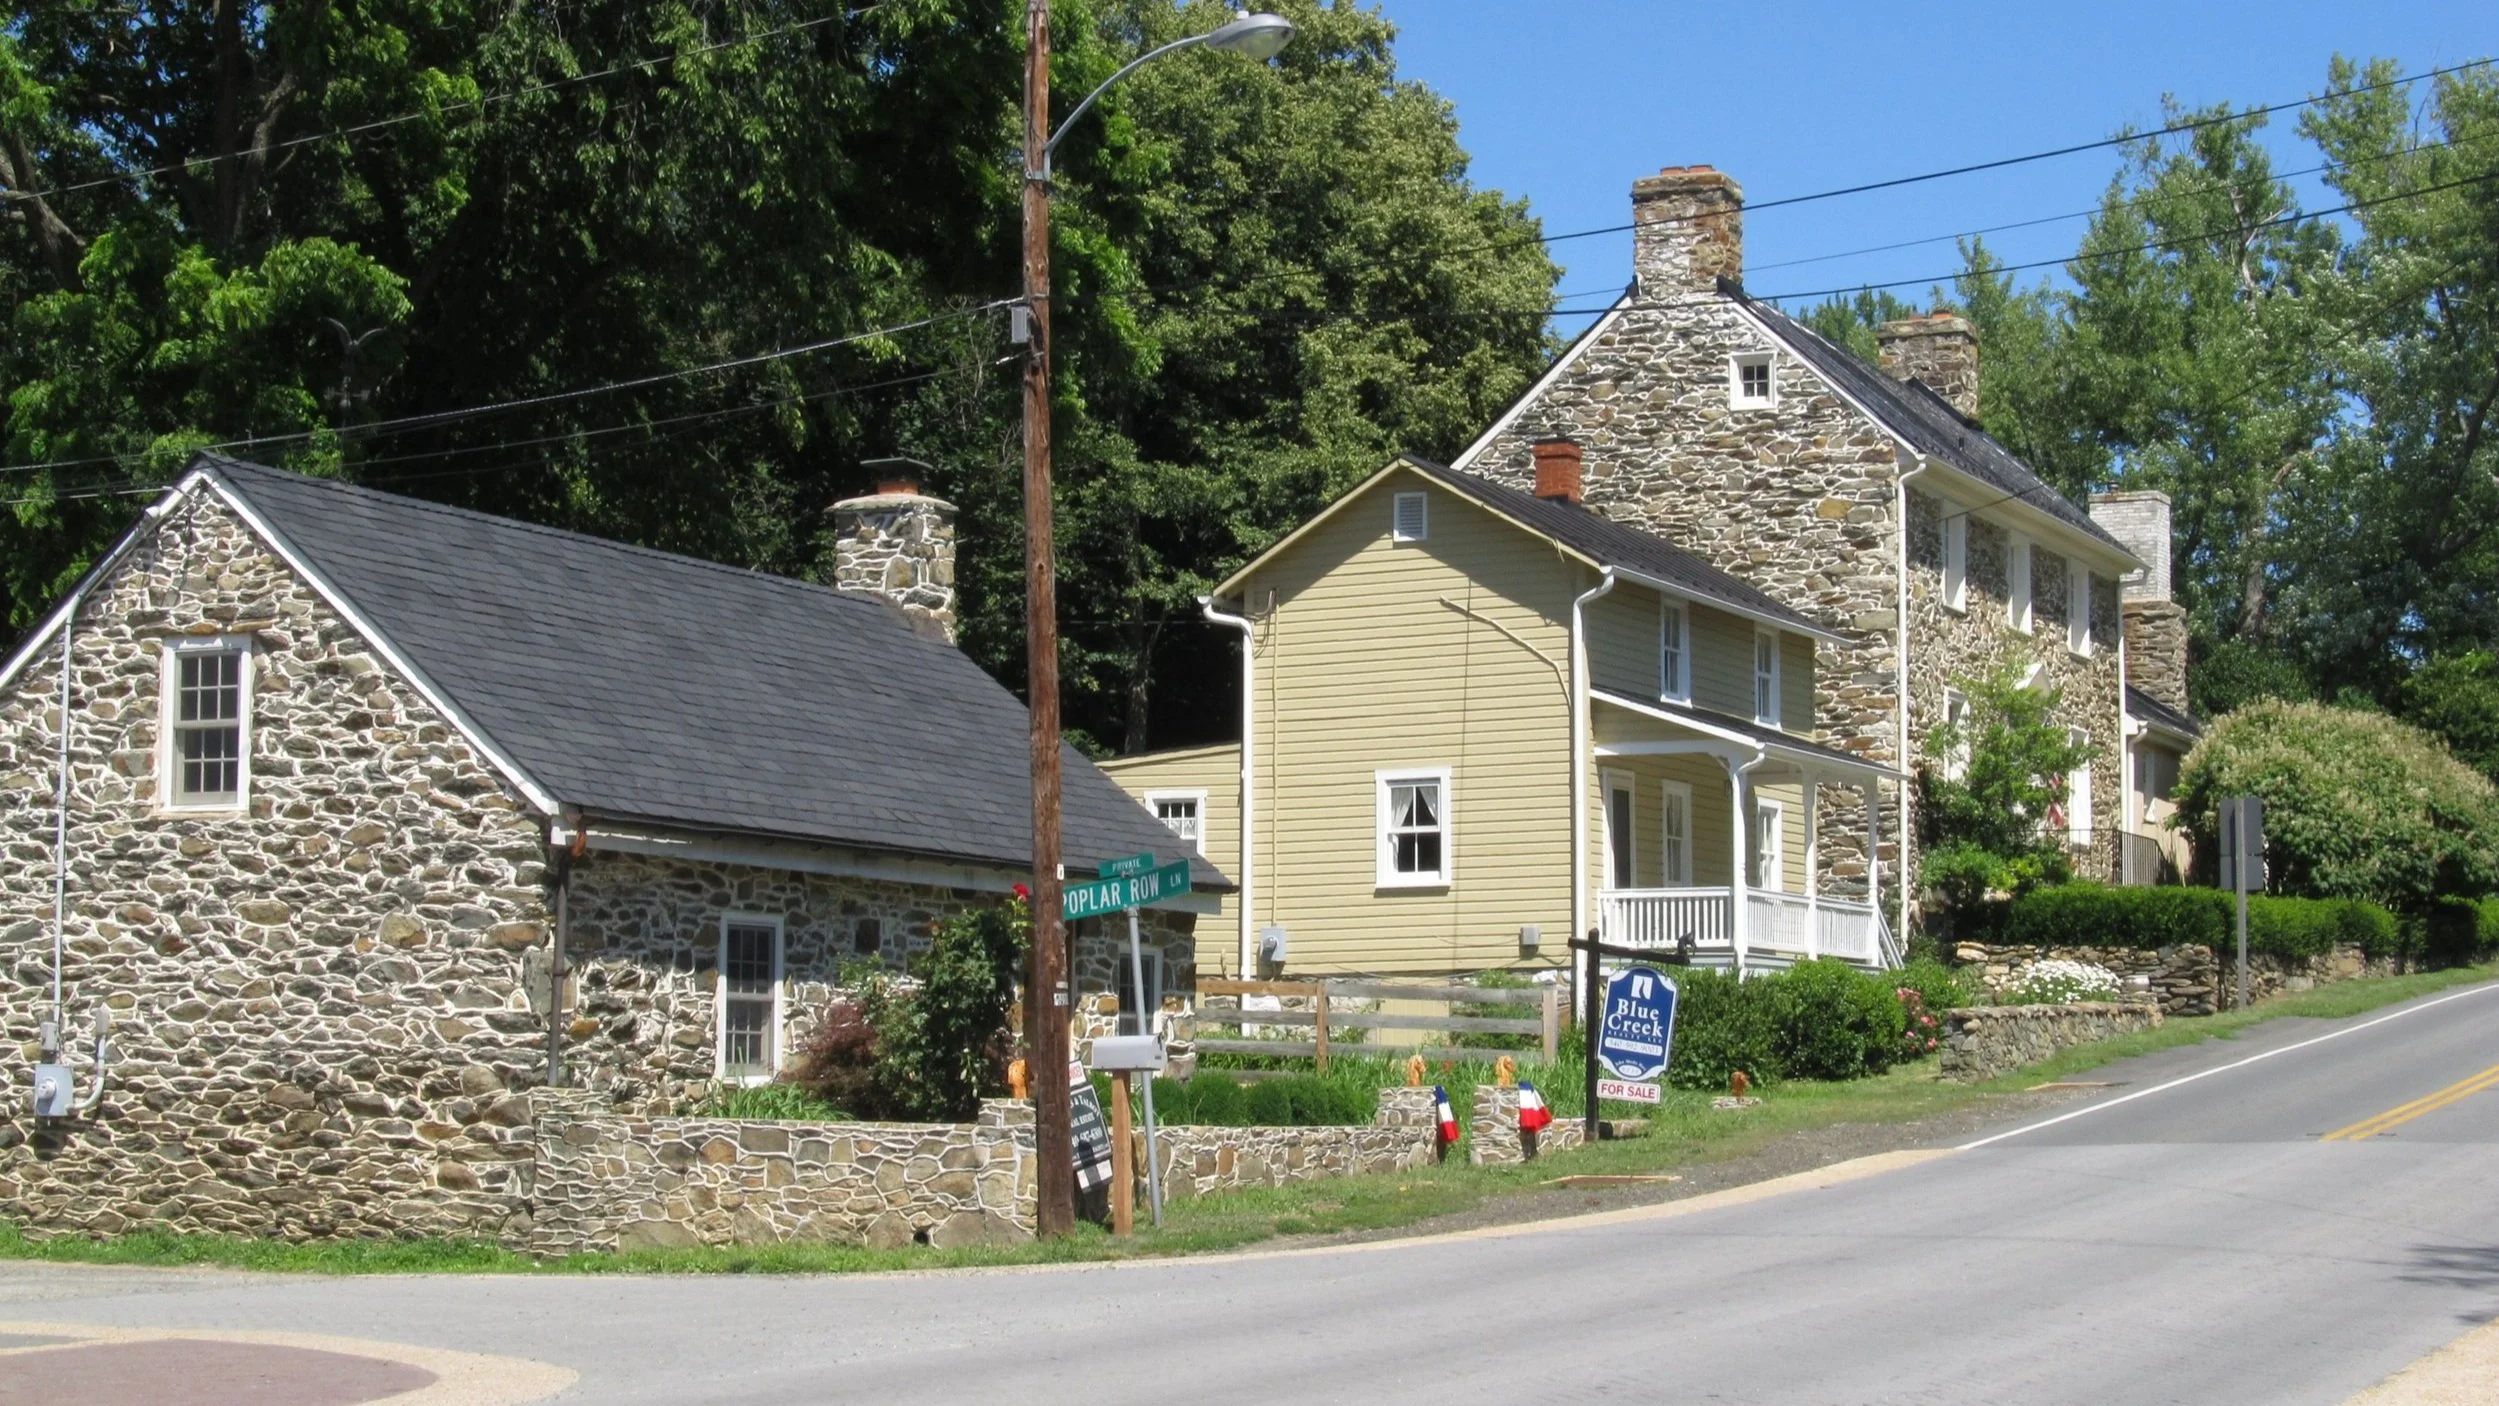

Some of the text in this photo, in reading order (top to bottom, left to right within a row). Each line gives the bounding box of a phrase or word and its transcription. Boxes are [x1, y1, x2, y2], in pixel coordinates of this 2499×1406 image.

[1112, 858, 1141, 873] PRIVATE
[1130, 872, 1159, 902] ROW
[1170, 873, 1181, 888] LN
[1617, 998, 1660, 1021] Blue
[1607, 1013, 1663, 1039] Creek
[1601, 1083, 1656, 1099] FOR SALE
